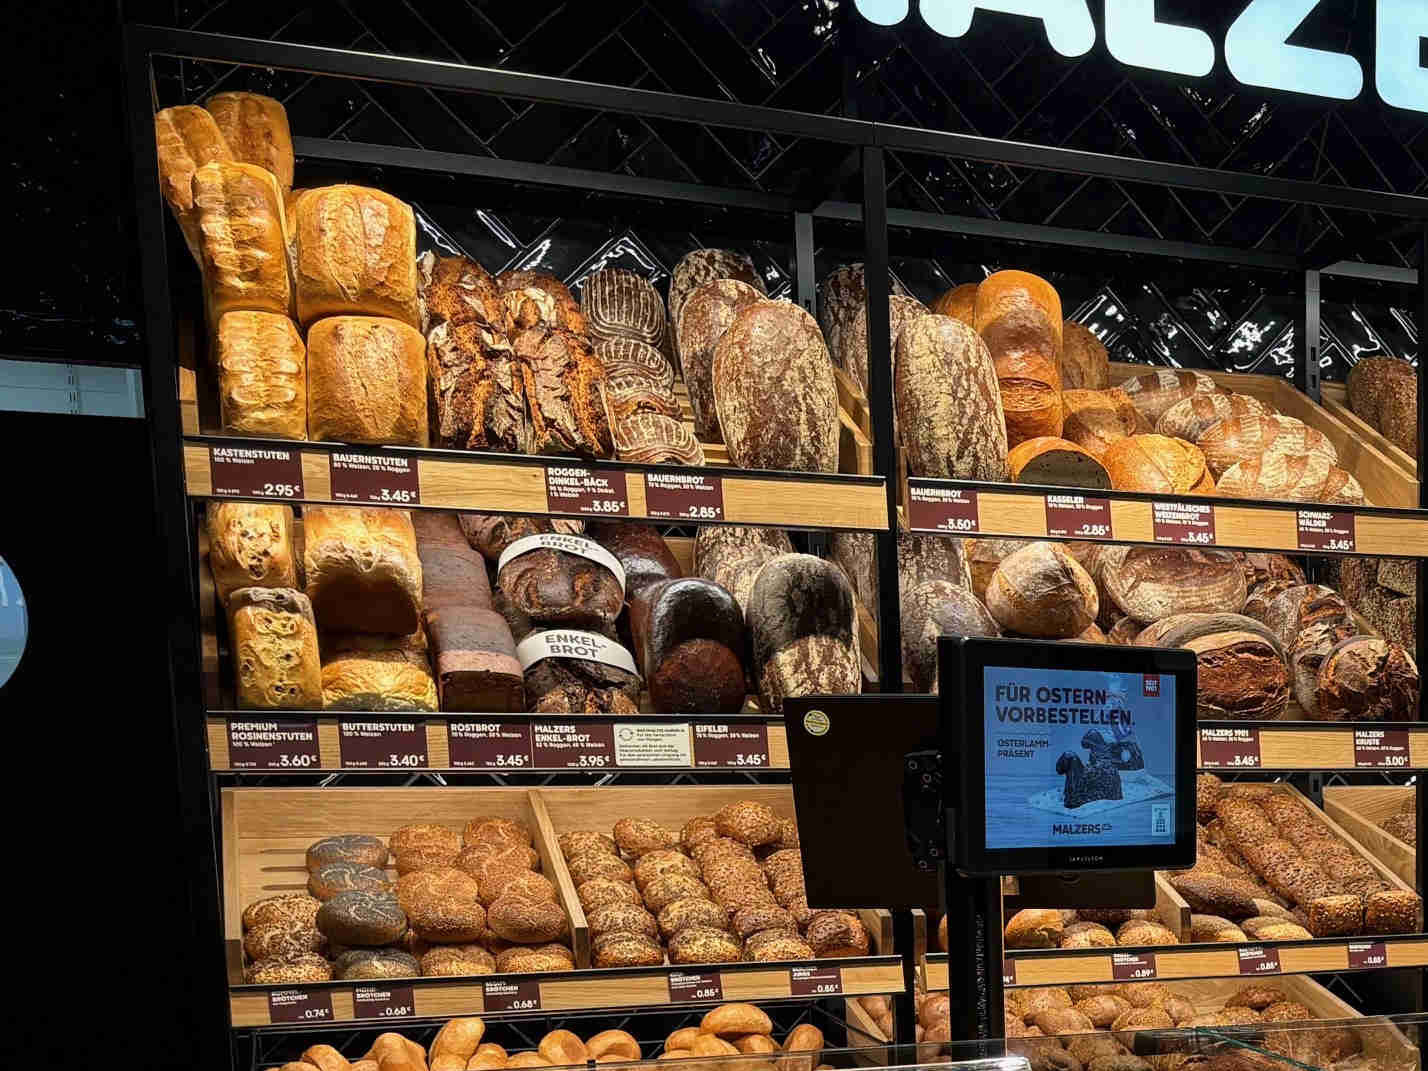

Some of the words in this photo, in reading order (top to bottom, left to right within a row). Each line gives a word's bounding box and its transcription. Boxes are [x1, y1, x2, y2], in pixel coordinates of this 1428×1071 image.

[213, 448, 290, 461] KASTENSTUTEN
[333, 453, 408, 467] BAUERNSTUTEN
[548, 468, 590, 478] ROGGEN-
[648, 474, 704, 485] BAUERNBROT
[264, 483, 300, 498] 2.95€
[381, 488, 417, 503] 3.45€
[593, 500, 625, 513] 3.85€
[689, 506, 721, 519] 2.85€
[550, 645, 599, 659] BROT
[996, 682, 1031, 702] FÜR
[1036, 687, 1107, 705] OSTERN
[996, 706, 1136, 726] VORBESTELLEN.
[231, 722, 278, 732] PREMIUM
[343, 722, 415, 732] BUTTERSTUTEN
[535, 725, 576, 734] MALZERS
[696, 725, 728, 734] EIFELER
[232, 732, 313, 742] ROSINENSTUTEN
[535, 734, 591, 743] ENKEL-BROT
[998, 738, 1049, 749] OSTERLAMM
[998, 748, 1034, 759] PRÄSENT
[281, 754, 317, 768] 3.60€
[390, 754, 425, 767] 3.40€
[496, 755, 528, 767] 3.45€
[579, 755, 610, 767] 3.95€
[736, 754, 766, 766] 3.45€
[1053, 824, 1102, 836] MALZERS
